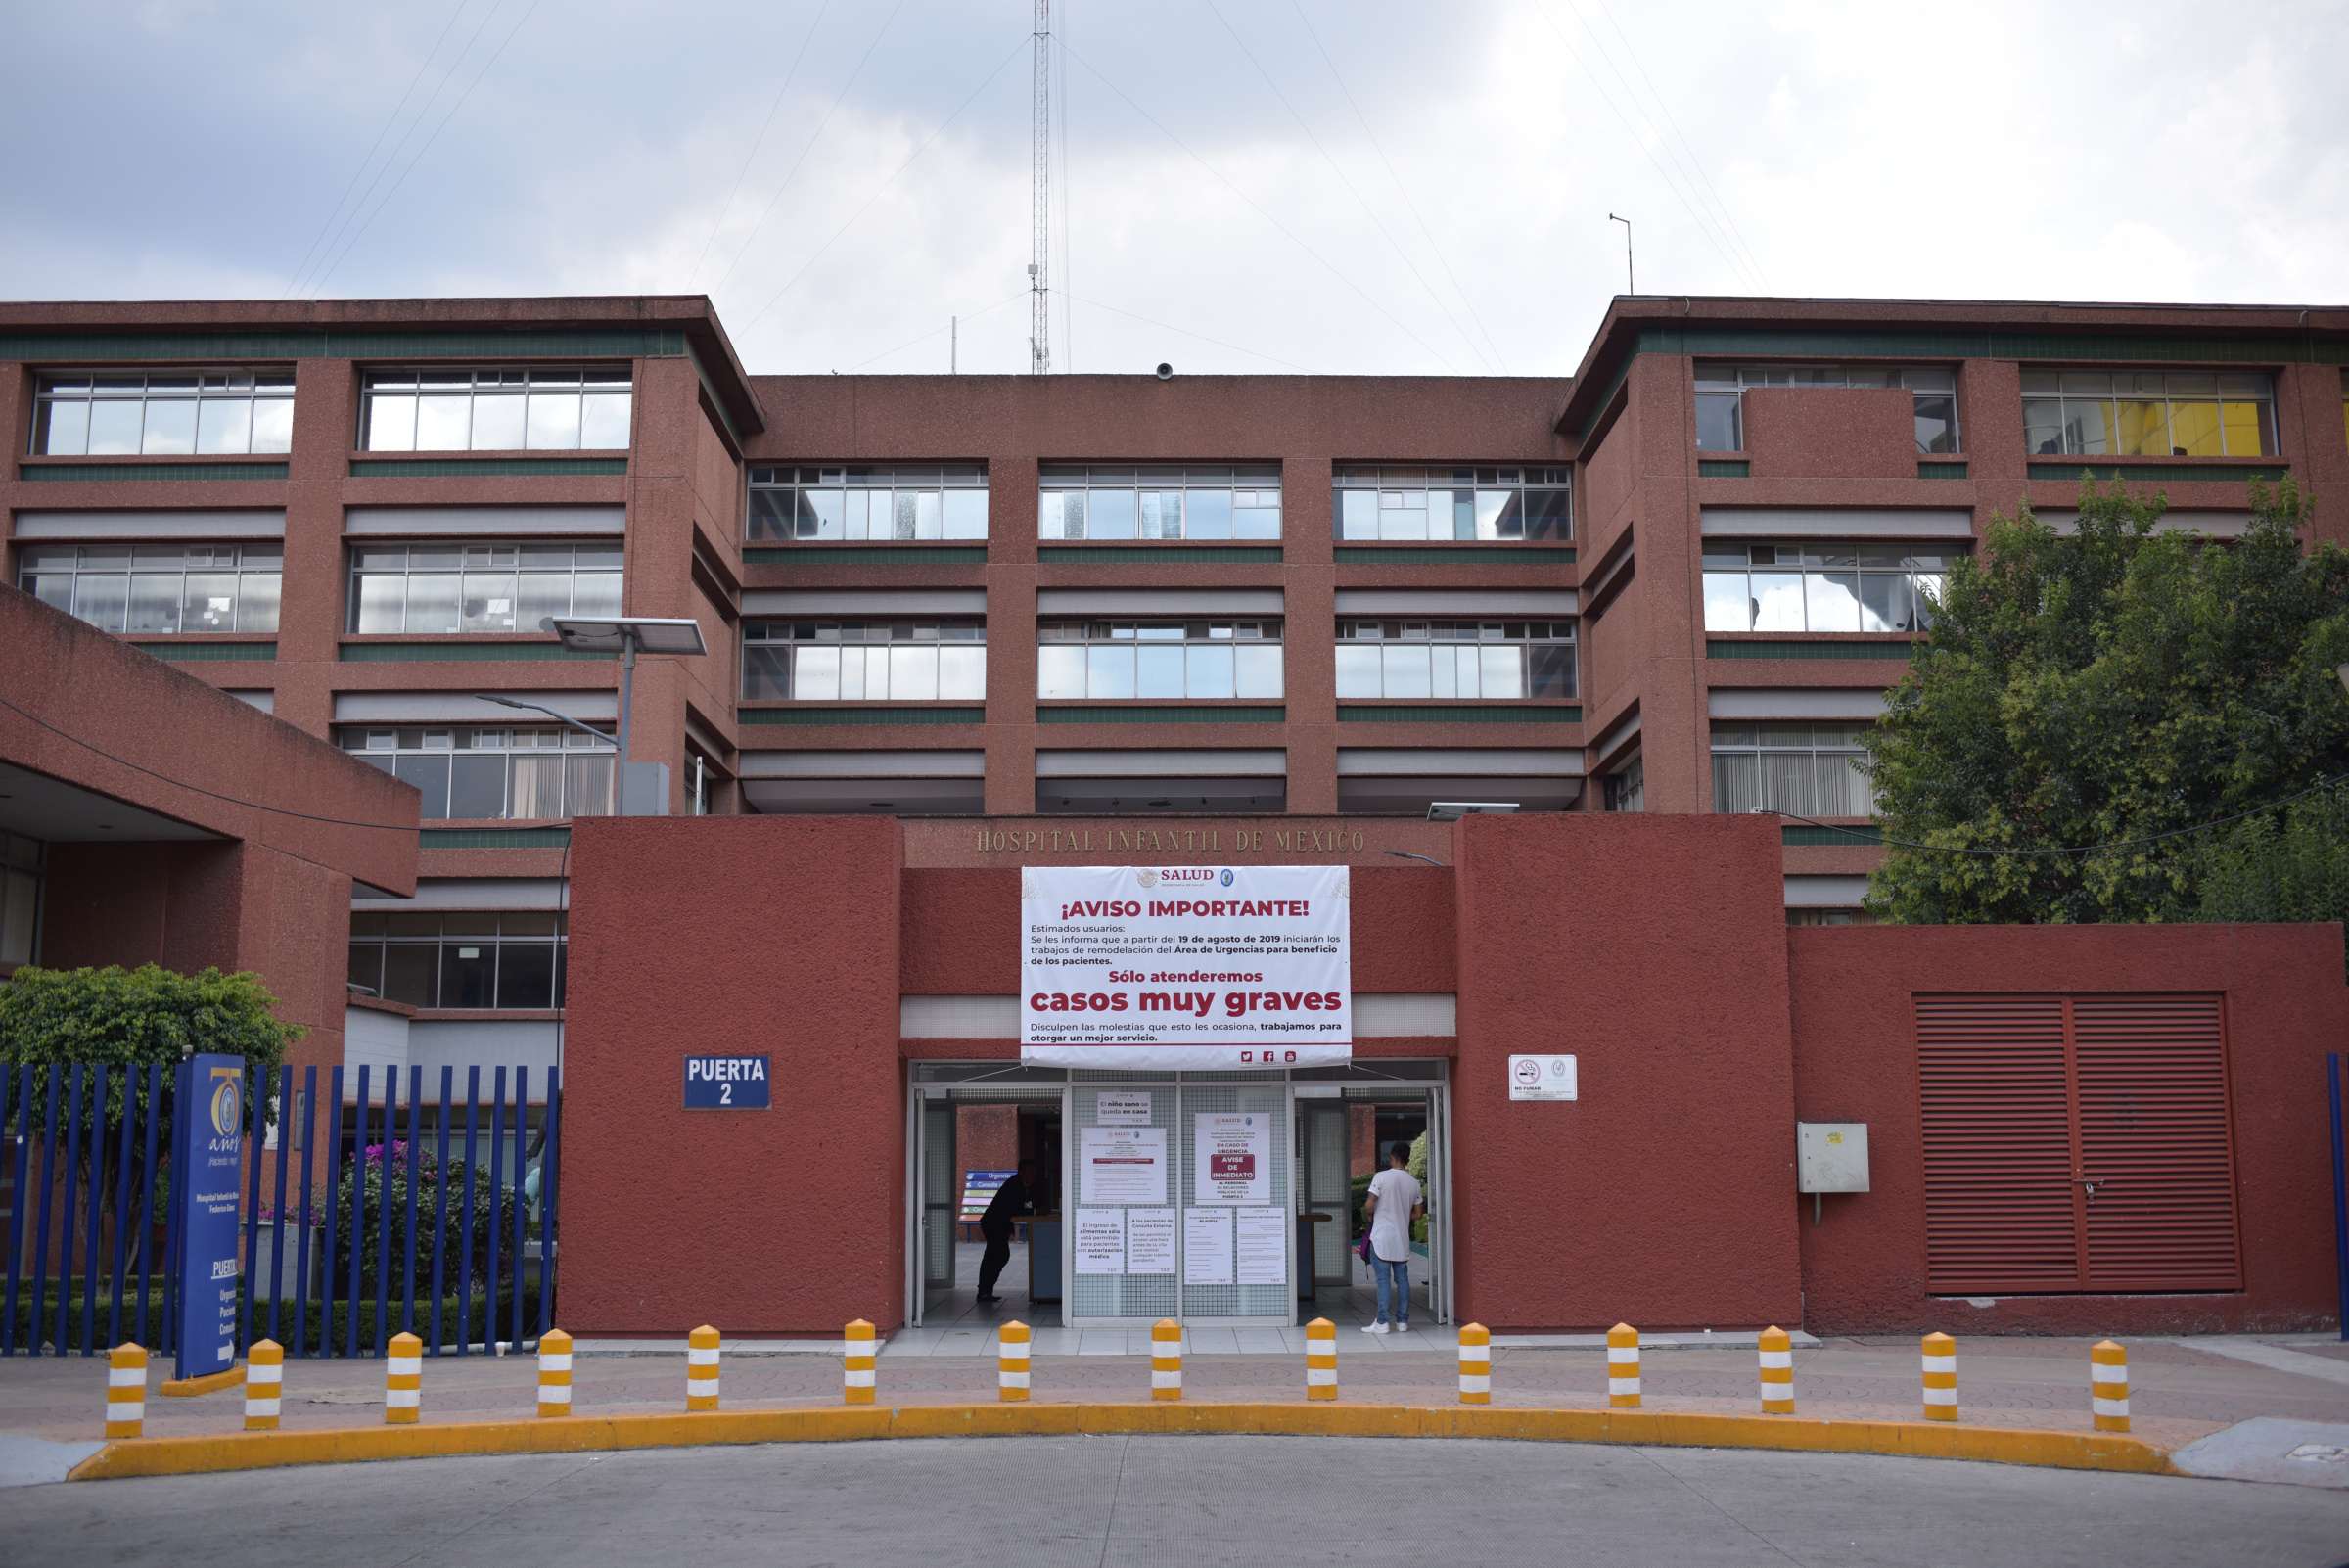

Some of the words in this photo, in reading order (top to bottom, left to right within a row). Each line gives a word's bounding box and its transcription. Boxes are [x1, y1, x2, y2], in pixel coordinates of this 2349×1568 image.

[978, 831, 1094, 852] HOSPITAL
[1108, 831, 1222, 852] INFANTIL
[1236, 831, 1263, 852] DE
[1276, 831, 1364, 852] MEXICO
[1162, 870, 1214, 880] SALUD
[1062, 900, 1141, 920] ¡AVISO
[1149, 900, 1310, 917] IMPORTANTE!
[1131, 936, 1158, 945] partir
[1031, 946, 1069, 955] trabajos
[1174, 945, 1197, 953] Área
[1062, 957, 1112, 966] pacientes.
[1109, 970, 1145, 983] Sólo
[1150, 970, 1263, 983] atenderemos
[1030, 992, 1128, 1011] casos
[1139, 992, 1216, 1018] muy
[1225, 992, 1342, 1017] graves
[1031, 1023, 1078, 1032] Disculpen
[1261, 1023, 1315, 1032] trabajamos
[1085, 1035, 1114, 1043] mejor
[689, 1059, 764, 1081] PUERTA
[720, 1083, 731, 1104] 2
[197, 1194, 216, 1204] Hospital
